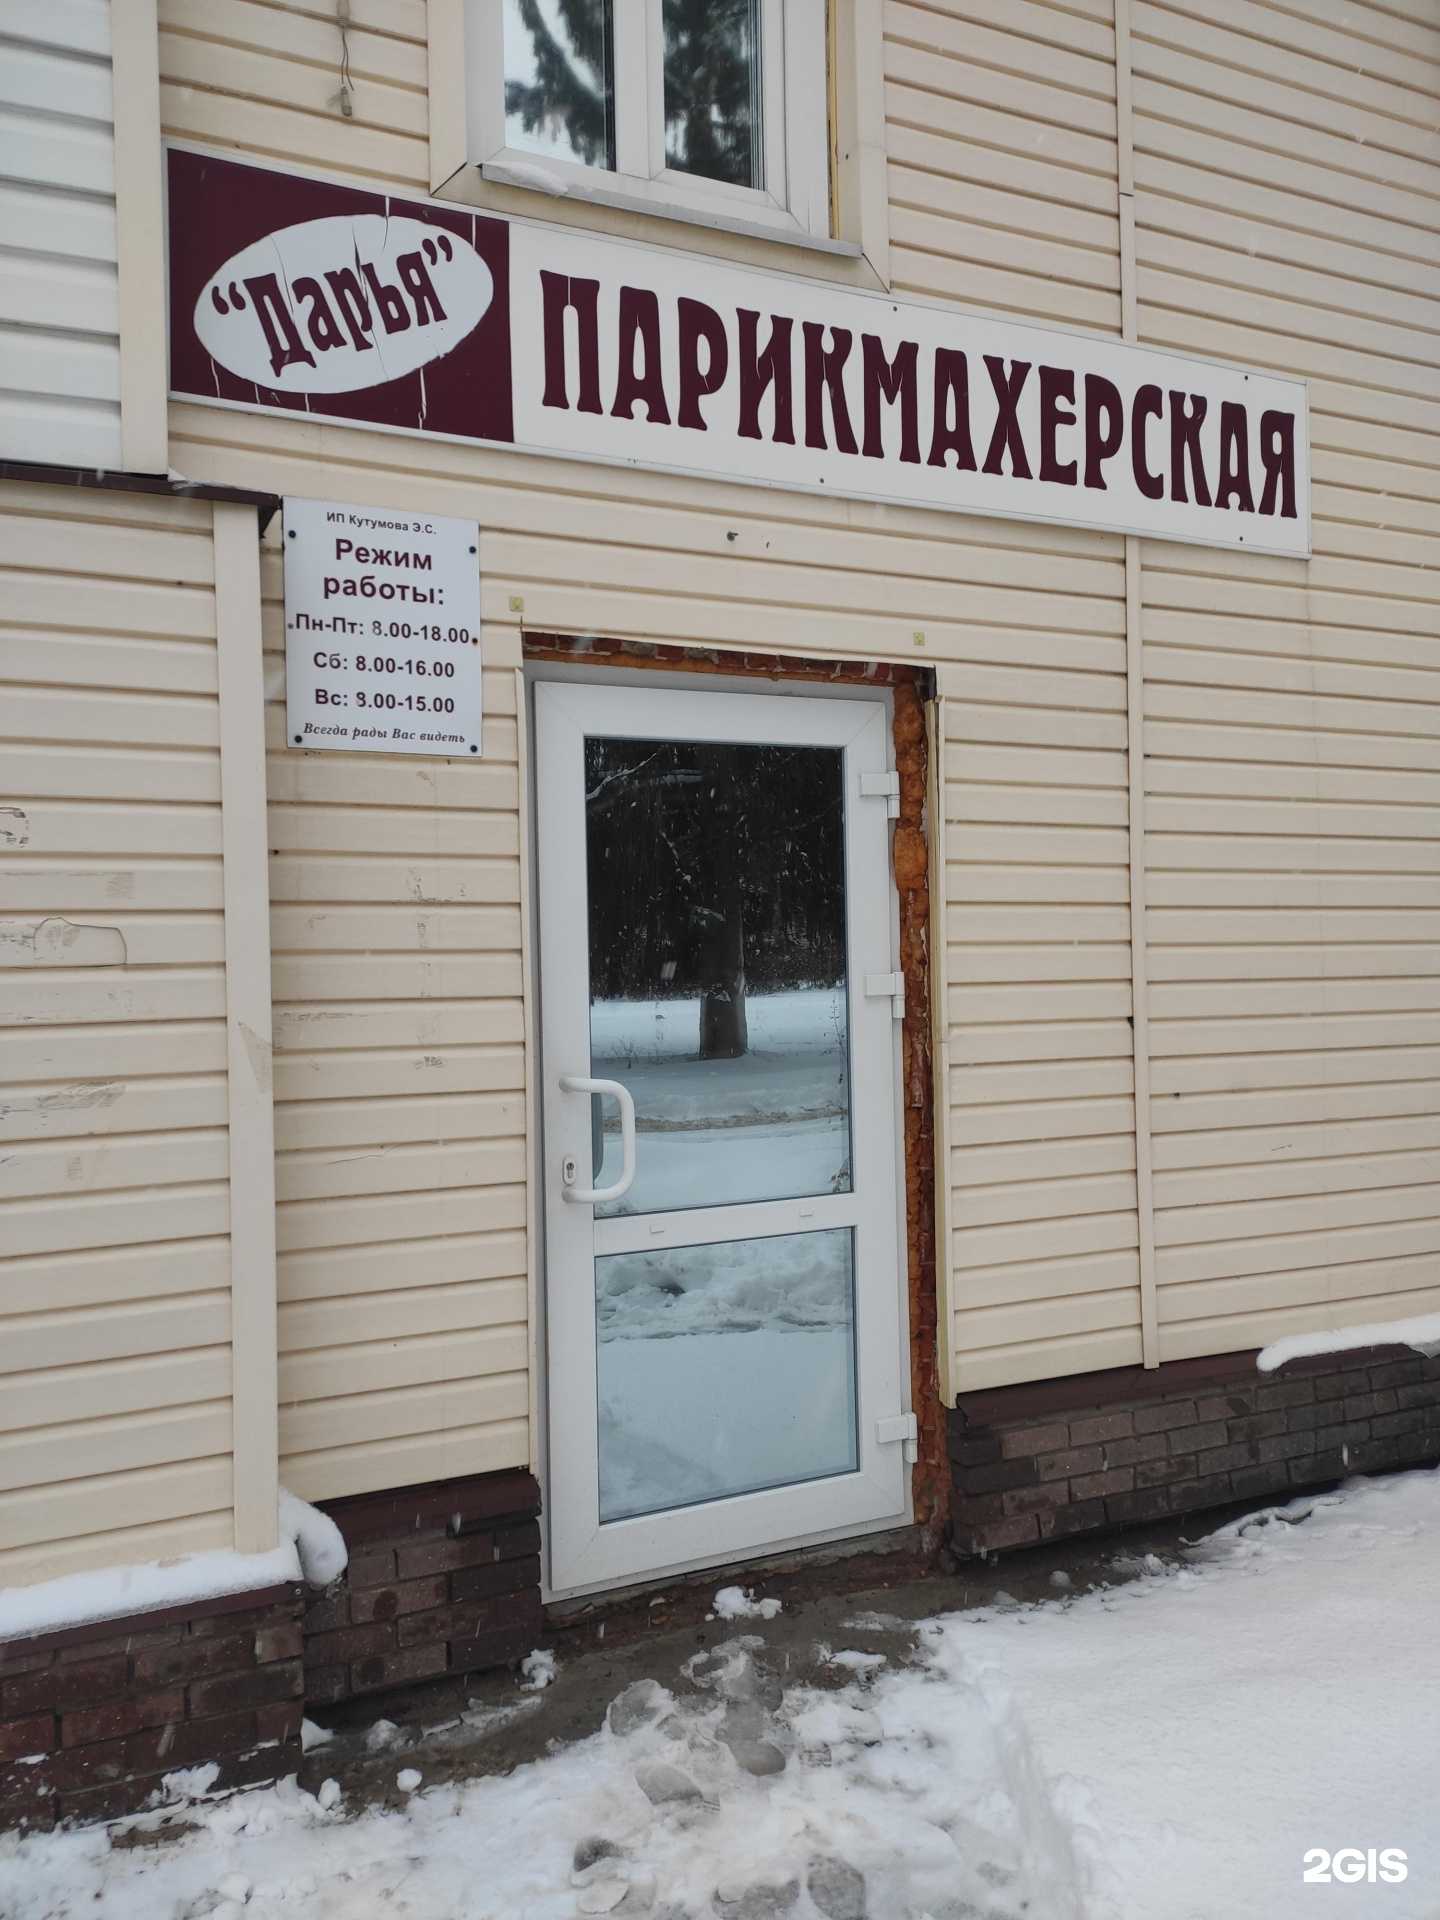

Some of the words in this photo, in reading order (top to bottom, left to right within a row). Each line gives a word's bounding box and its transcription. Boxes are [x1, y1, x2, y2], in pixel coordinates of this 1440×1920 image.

[211, 234, 453, 378] “Дарья”
[540, 269, 1297, 519] ПАРИКМАХЕРСКАЯ
[326, 511, 345, 523] ИП
[349, 514, 409, 531] Кутумова
[412, 522, 437, 534] Э.С.
[335, 538, 432, 570] Режим
[323, 575, 444, 605] работы:
[296, 613, 365, 635] Пн-Пт:
[372, 620, 469, 644] 8.00-18.00
[313, 652, 348, 670] Сб:
[356, 655, 455, 678] 8.00-16.00
[315, 689, 348, 707] Вс:
[303, 723, 348, 737] Всегда
[352, 727, 388, 740] рады
[392, 729, 416, 740] Вас
[420, 732, 466, 744] видеть
